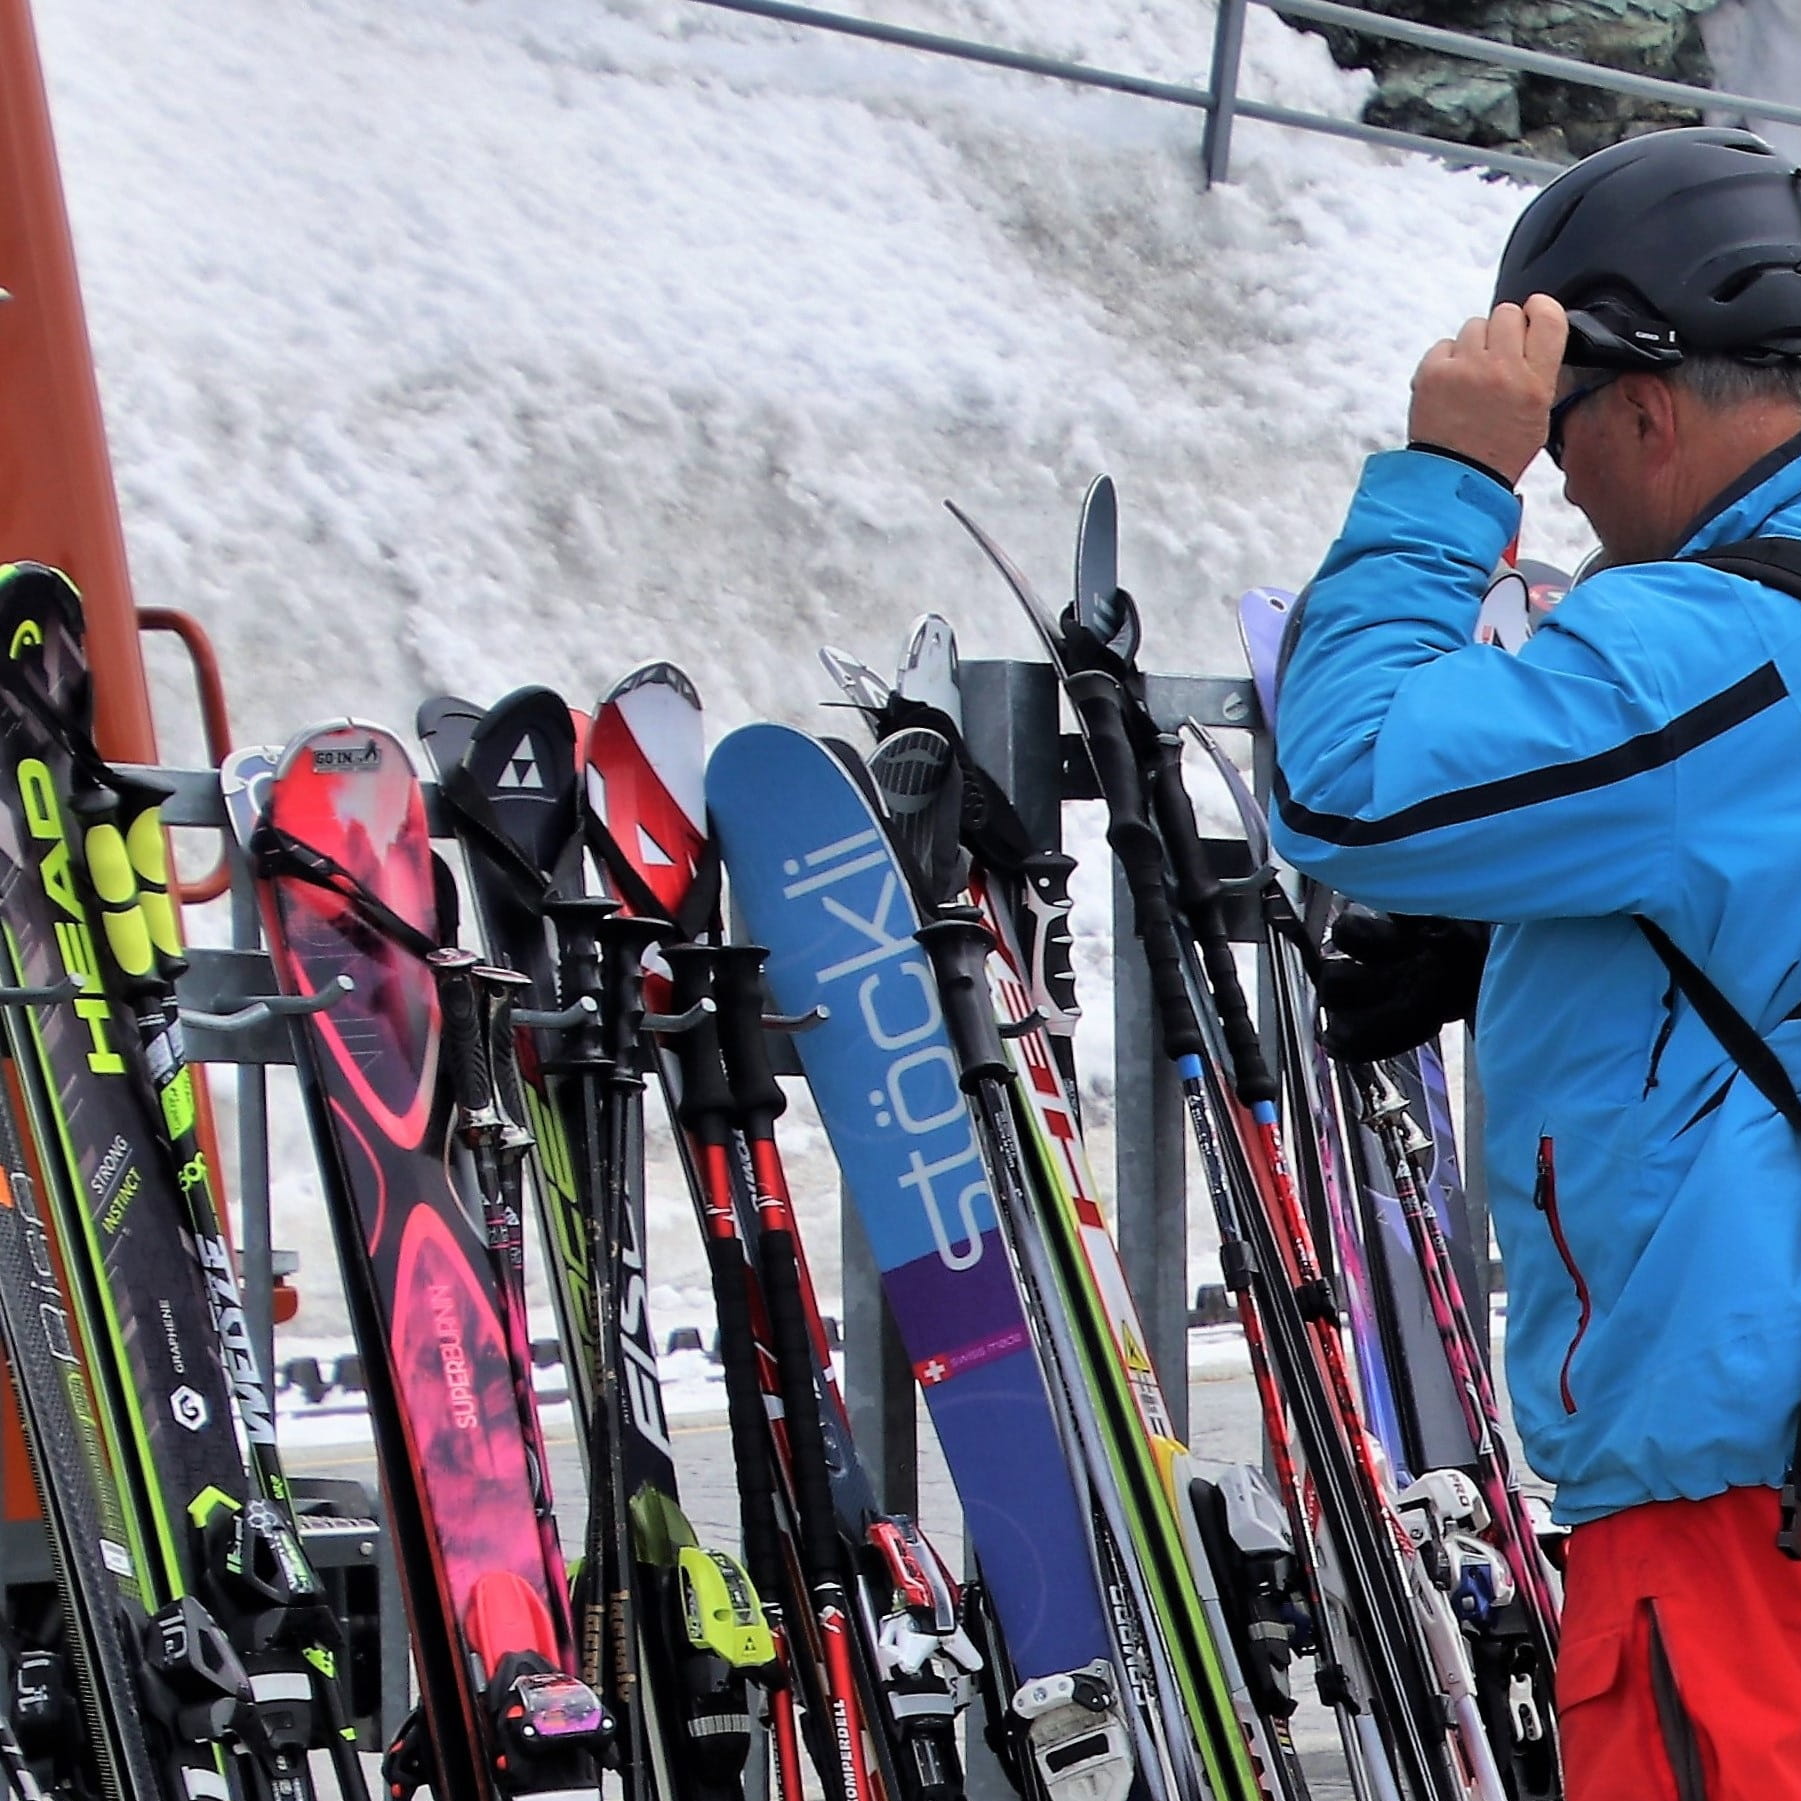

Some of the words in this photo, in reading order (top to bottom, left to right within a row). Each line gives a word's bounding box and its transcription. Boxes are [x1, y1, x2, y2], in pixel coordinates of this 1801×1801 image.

[17, 758, 127, 1074] HEAD
[782, 828, 993, 1273] stöckli
[89, 1133, 130, 1196] STRONG
[101, 1166, 143, 1235] INSTINCT
